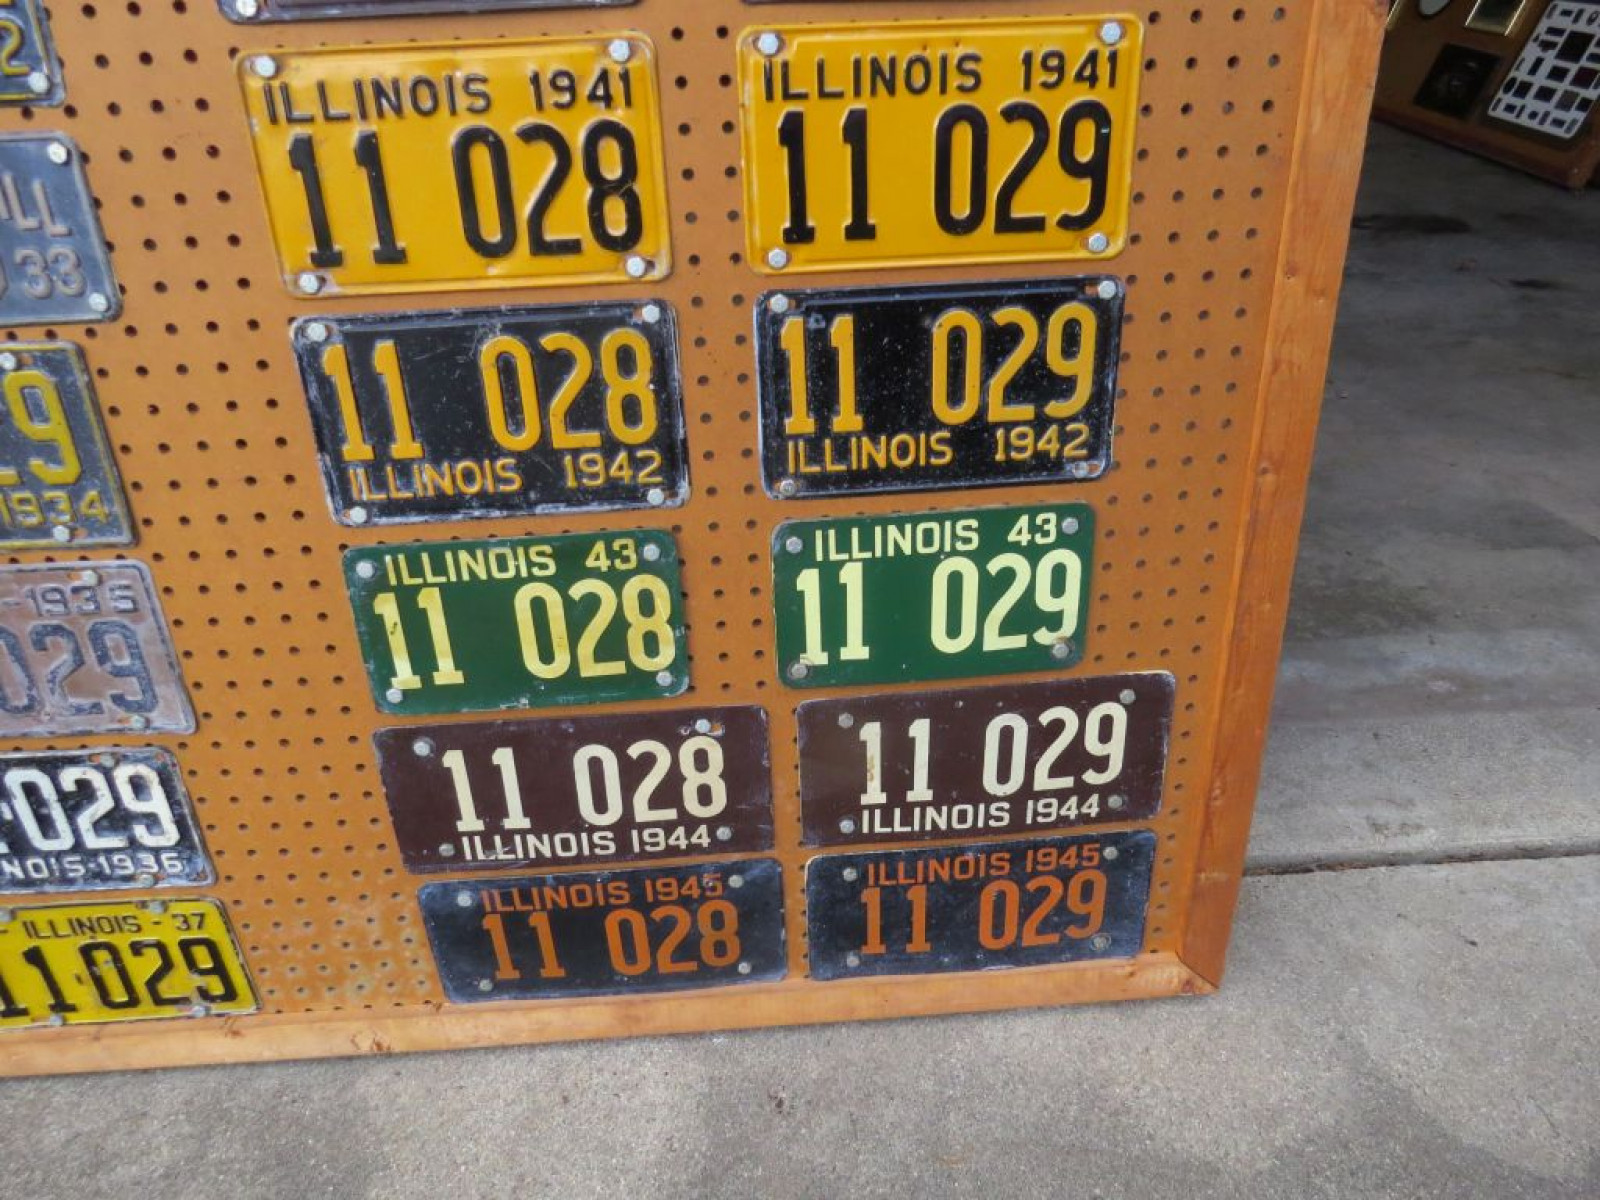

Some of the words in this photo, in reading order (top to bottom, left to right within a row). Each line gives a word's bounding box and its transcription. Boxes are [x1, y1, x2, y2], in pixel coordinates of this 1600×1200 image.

[263, 73, 492, 125] ILLINOIS
[529, 66, 633, 112] 1941
[764, 51, 982, 102] ILLINOIS
[1021, 48, 1118, 92] 1941
[288, 130, 407, 268] 11
[451, 119, 644, 260] 028
[778, 107, 876, 244] 11
[934, 99, 1112, 236] 029
[15, 247, 86, 299] 33
[322, 340, 424, 461] 11
[480, 328, 657, 451] 028
[780, 313, 863, 434] 11
[932, 302, 1096, 425] 029
[0, 370, 82, 486] 9
[787, 433, 952, 474] ILLINOIS
[995, 425, 1089, 462] 1942
[349, 458, 522, 501] ILLINOIS
[565, 450, 663, 488] 1942
[385, 545, 556, 586] ILLINOIS
[586, 538, 638, 572] 43
[815, 519, 979, 562] ILLINOIS
[1007, 512, 1057, 546] 43
[25, 583, 140, 617] 1935
[796, 561, 869, 666] 11
[931, 548, 1081, 653] 029
[373, 587, 464, 689] 11
[514, 574, 675, 679] 028
[859, 718, 934, 806] 11
[982, 701, 1127, 796] 029
[442, 746, 531, 832] 11
[573, 736, 727, 826] 028
[862, 801, 1010, 834] ILLINOIS
[1026, 793, 1099, 824] 1944
[462, 831, 616, 861] ILLINOIS
[632, 824, 711, 854] 1944
[868, 852, 1010, 886] ILLINOIS
[1026, 843, 1099, 872] 1945
[481, 881, 630, 912] ILLINOIS
[645, 873, 723, 902] 1945
[861, 885, 930, 954] 11
[979, 870, 1107, 950] 029
[22, 915, 142, 939] ILLINOIS
[172, 913, 206, 932] 37
[482, 911, 565, 980] 11
[604, 900, 741, 976] 028
